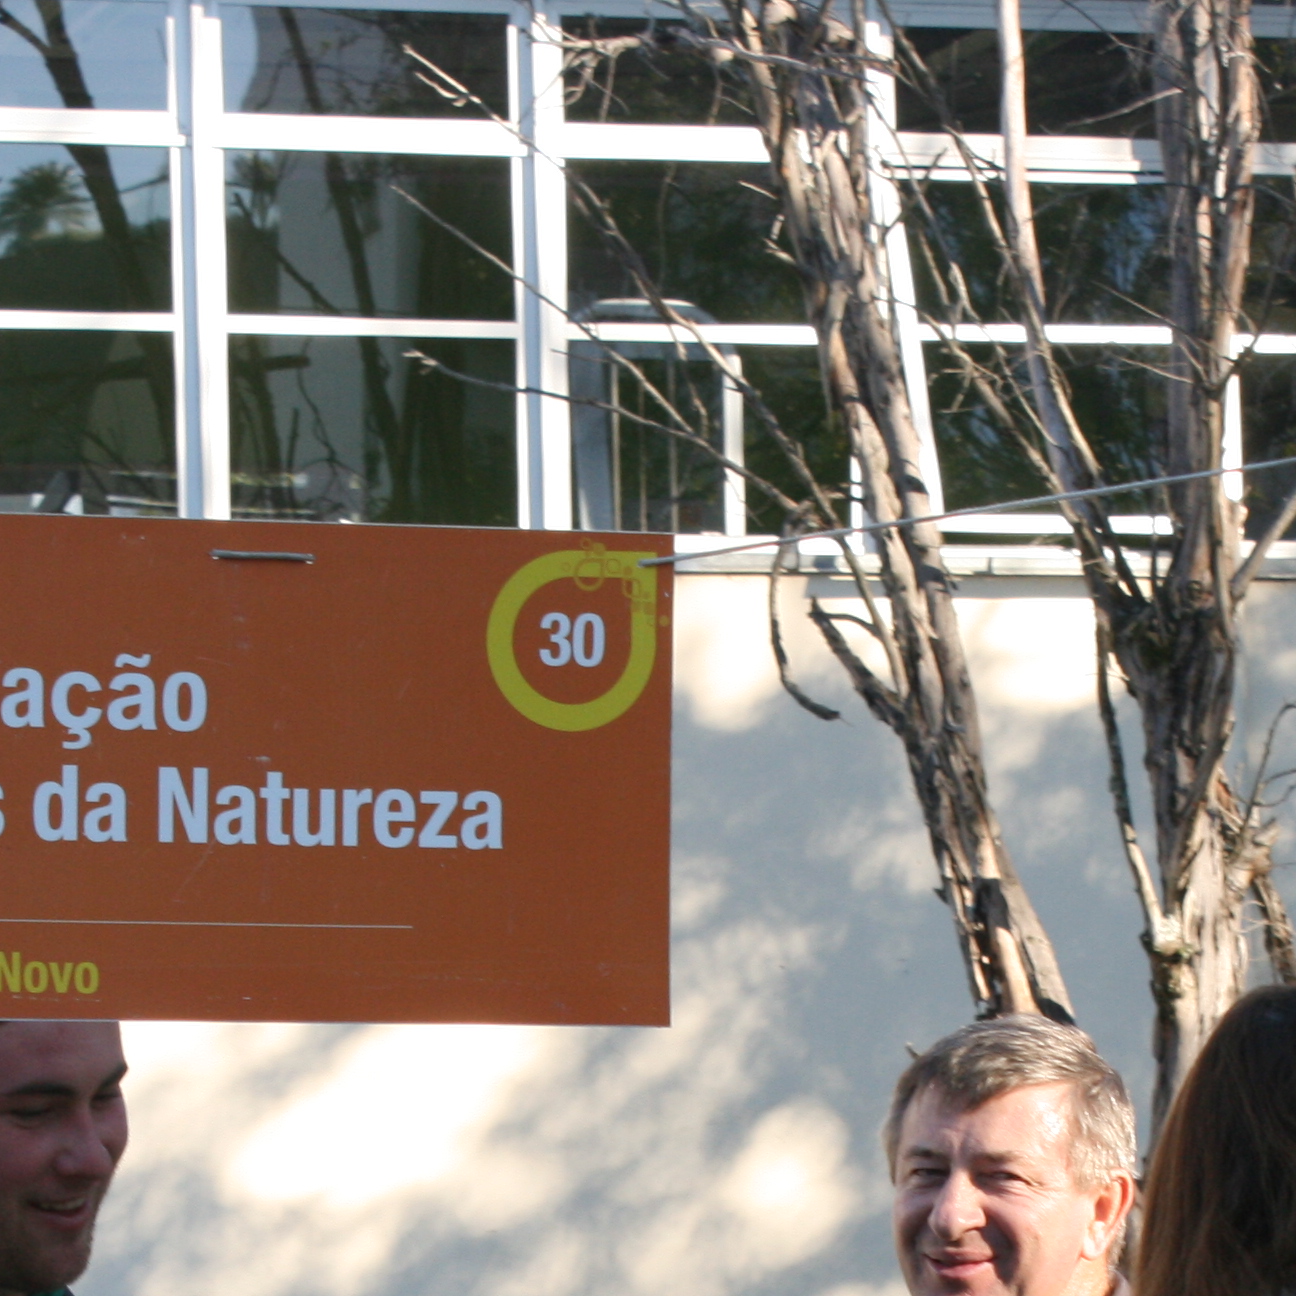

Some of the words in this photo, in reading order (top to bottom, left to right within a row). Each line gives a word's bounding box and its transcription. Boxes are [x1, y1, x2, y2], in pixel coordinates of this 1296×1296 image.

[538, 611, 606, 668] 30
[32, 764, 128, 843] da
[157, 766, 503, 851] Natureza
